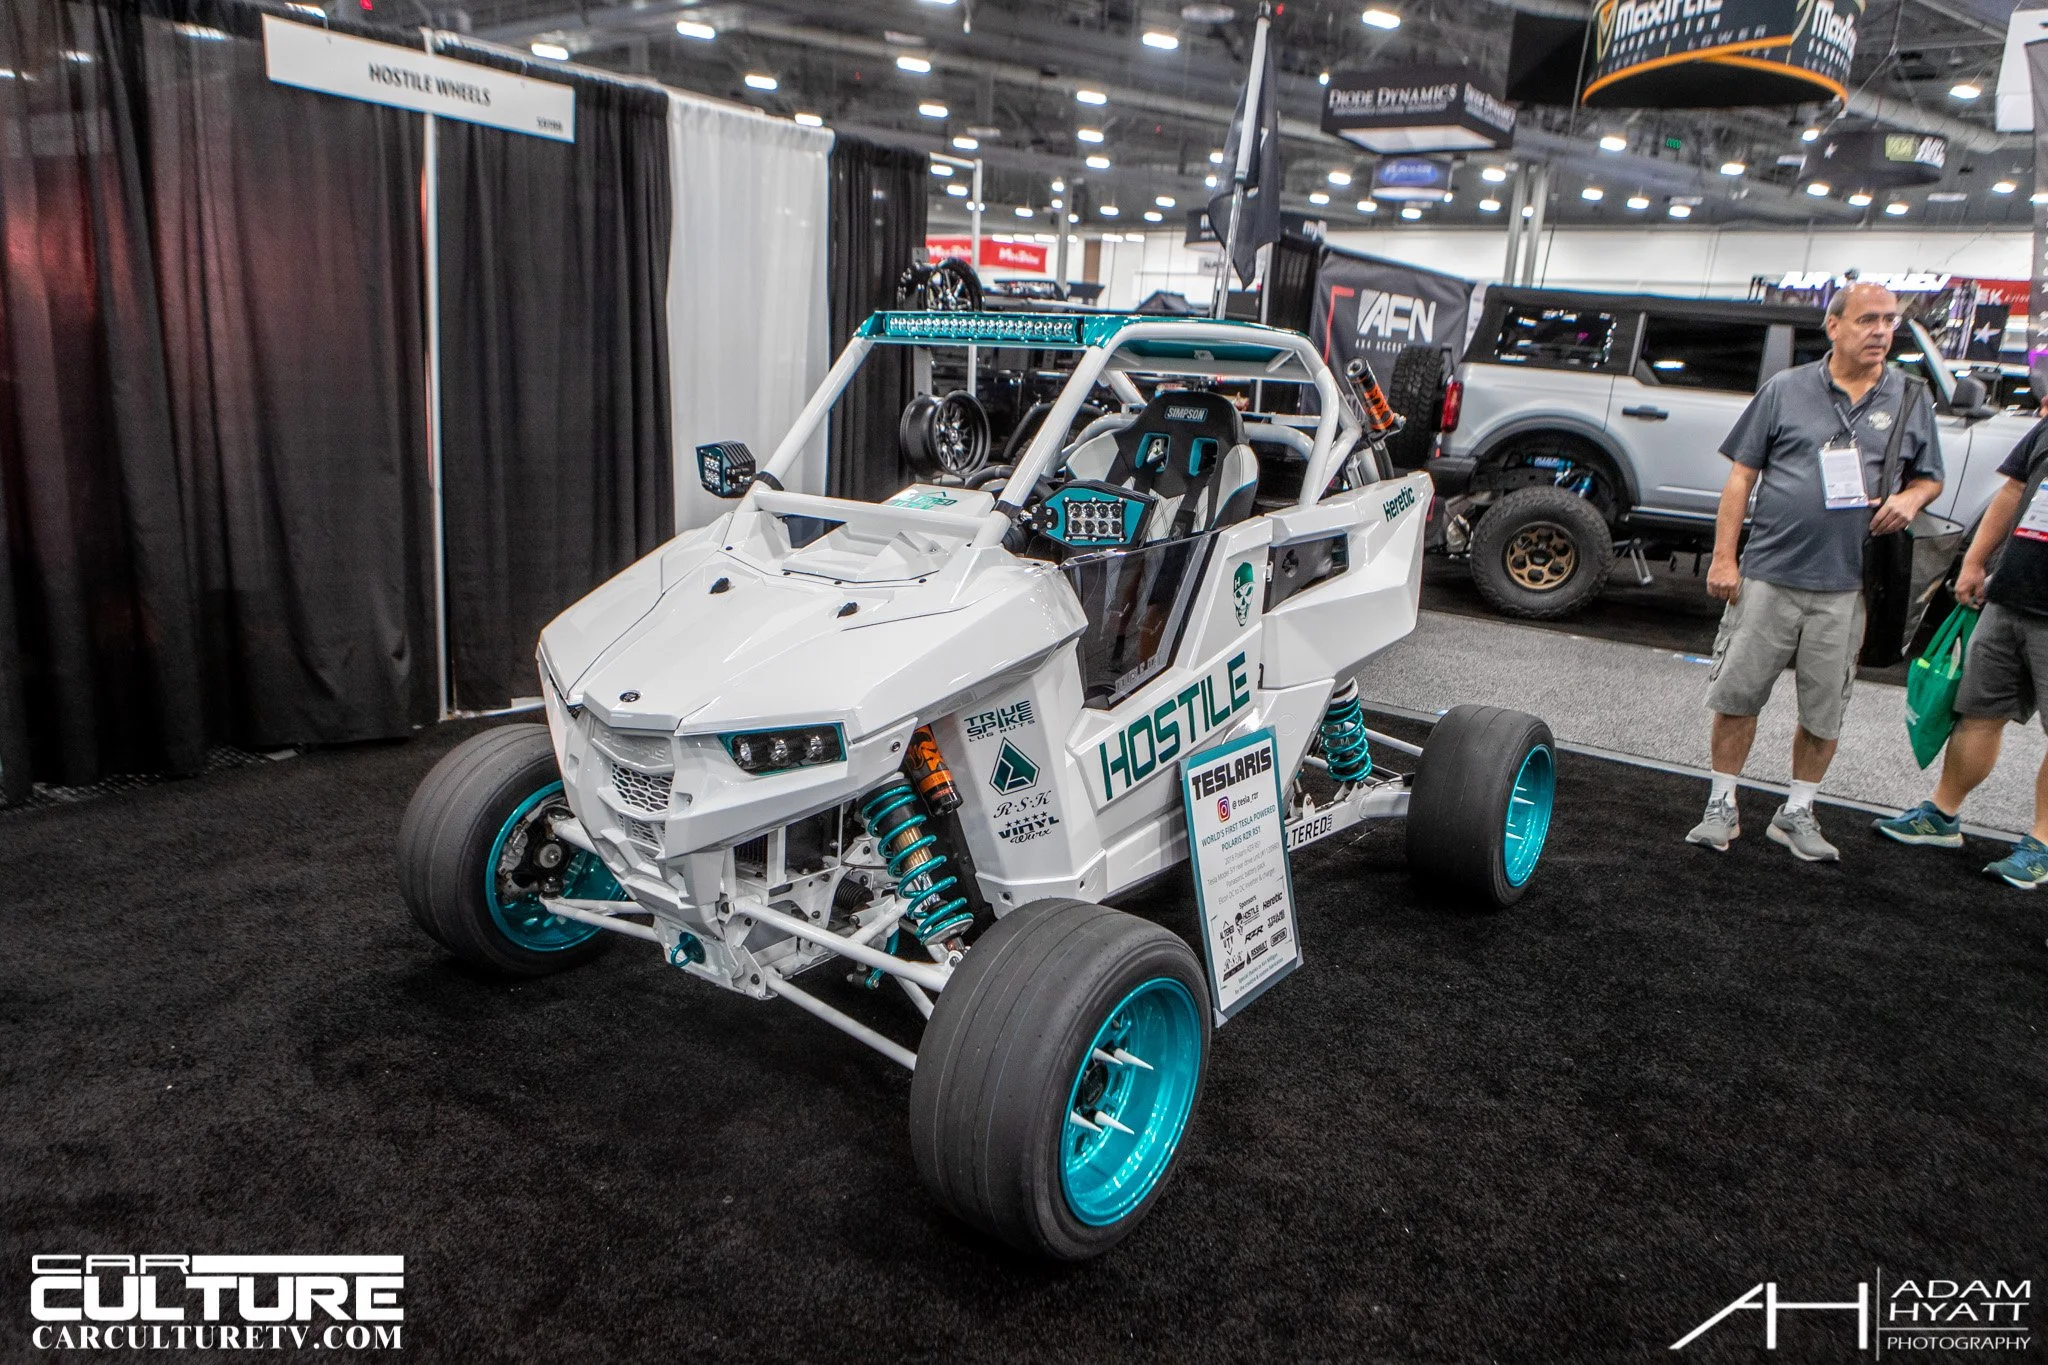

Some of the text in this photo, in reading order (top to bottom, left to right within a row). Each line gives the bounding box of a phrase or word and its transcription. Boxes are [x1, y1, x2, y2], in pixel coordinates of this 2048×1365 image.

[368, 62, 492, 107] HOSTILE WHEELS
[1329, 88, 1374, 109] DIODE
[1377, 83, 1458, 108] DYNAMICS
[1358, 291, 1437, 343] AFN
[1167, 406, 1205, 421] SIMPSON
[1383, 486, 1415, 522] Heretic
[964, 700, 1031, 727] TRUE
[966, 711, 1034, 738] SPIKE
[1098, 651, 1250, 801] HOSTILE
[969, 719, 1035, 743] LUG NUTS
[1191, 747, 1272, 801] TESLARIS
[998, 816, 1060, 839] VINYL
[1201, 805, 1275, 847] WORLD'S FIRST TESLA POWERED
[1221, 826, 1261, 851] POLARIS RZR RS1
[1285, 816, 1327, 849] LTERED
[1238, 895, 1256, 909] Sponsors
[1242, 906, 1259, 920] HOSTILE
[1262, 892, 1283, 909] Heretic
